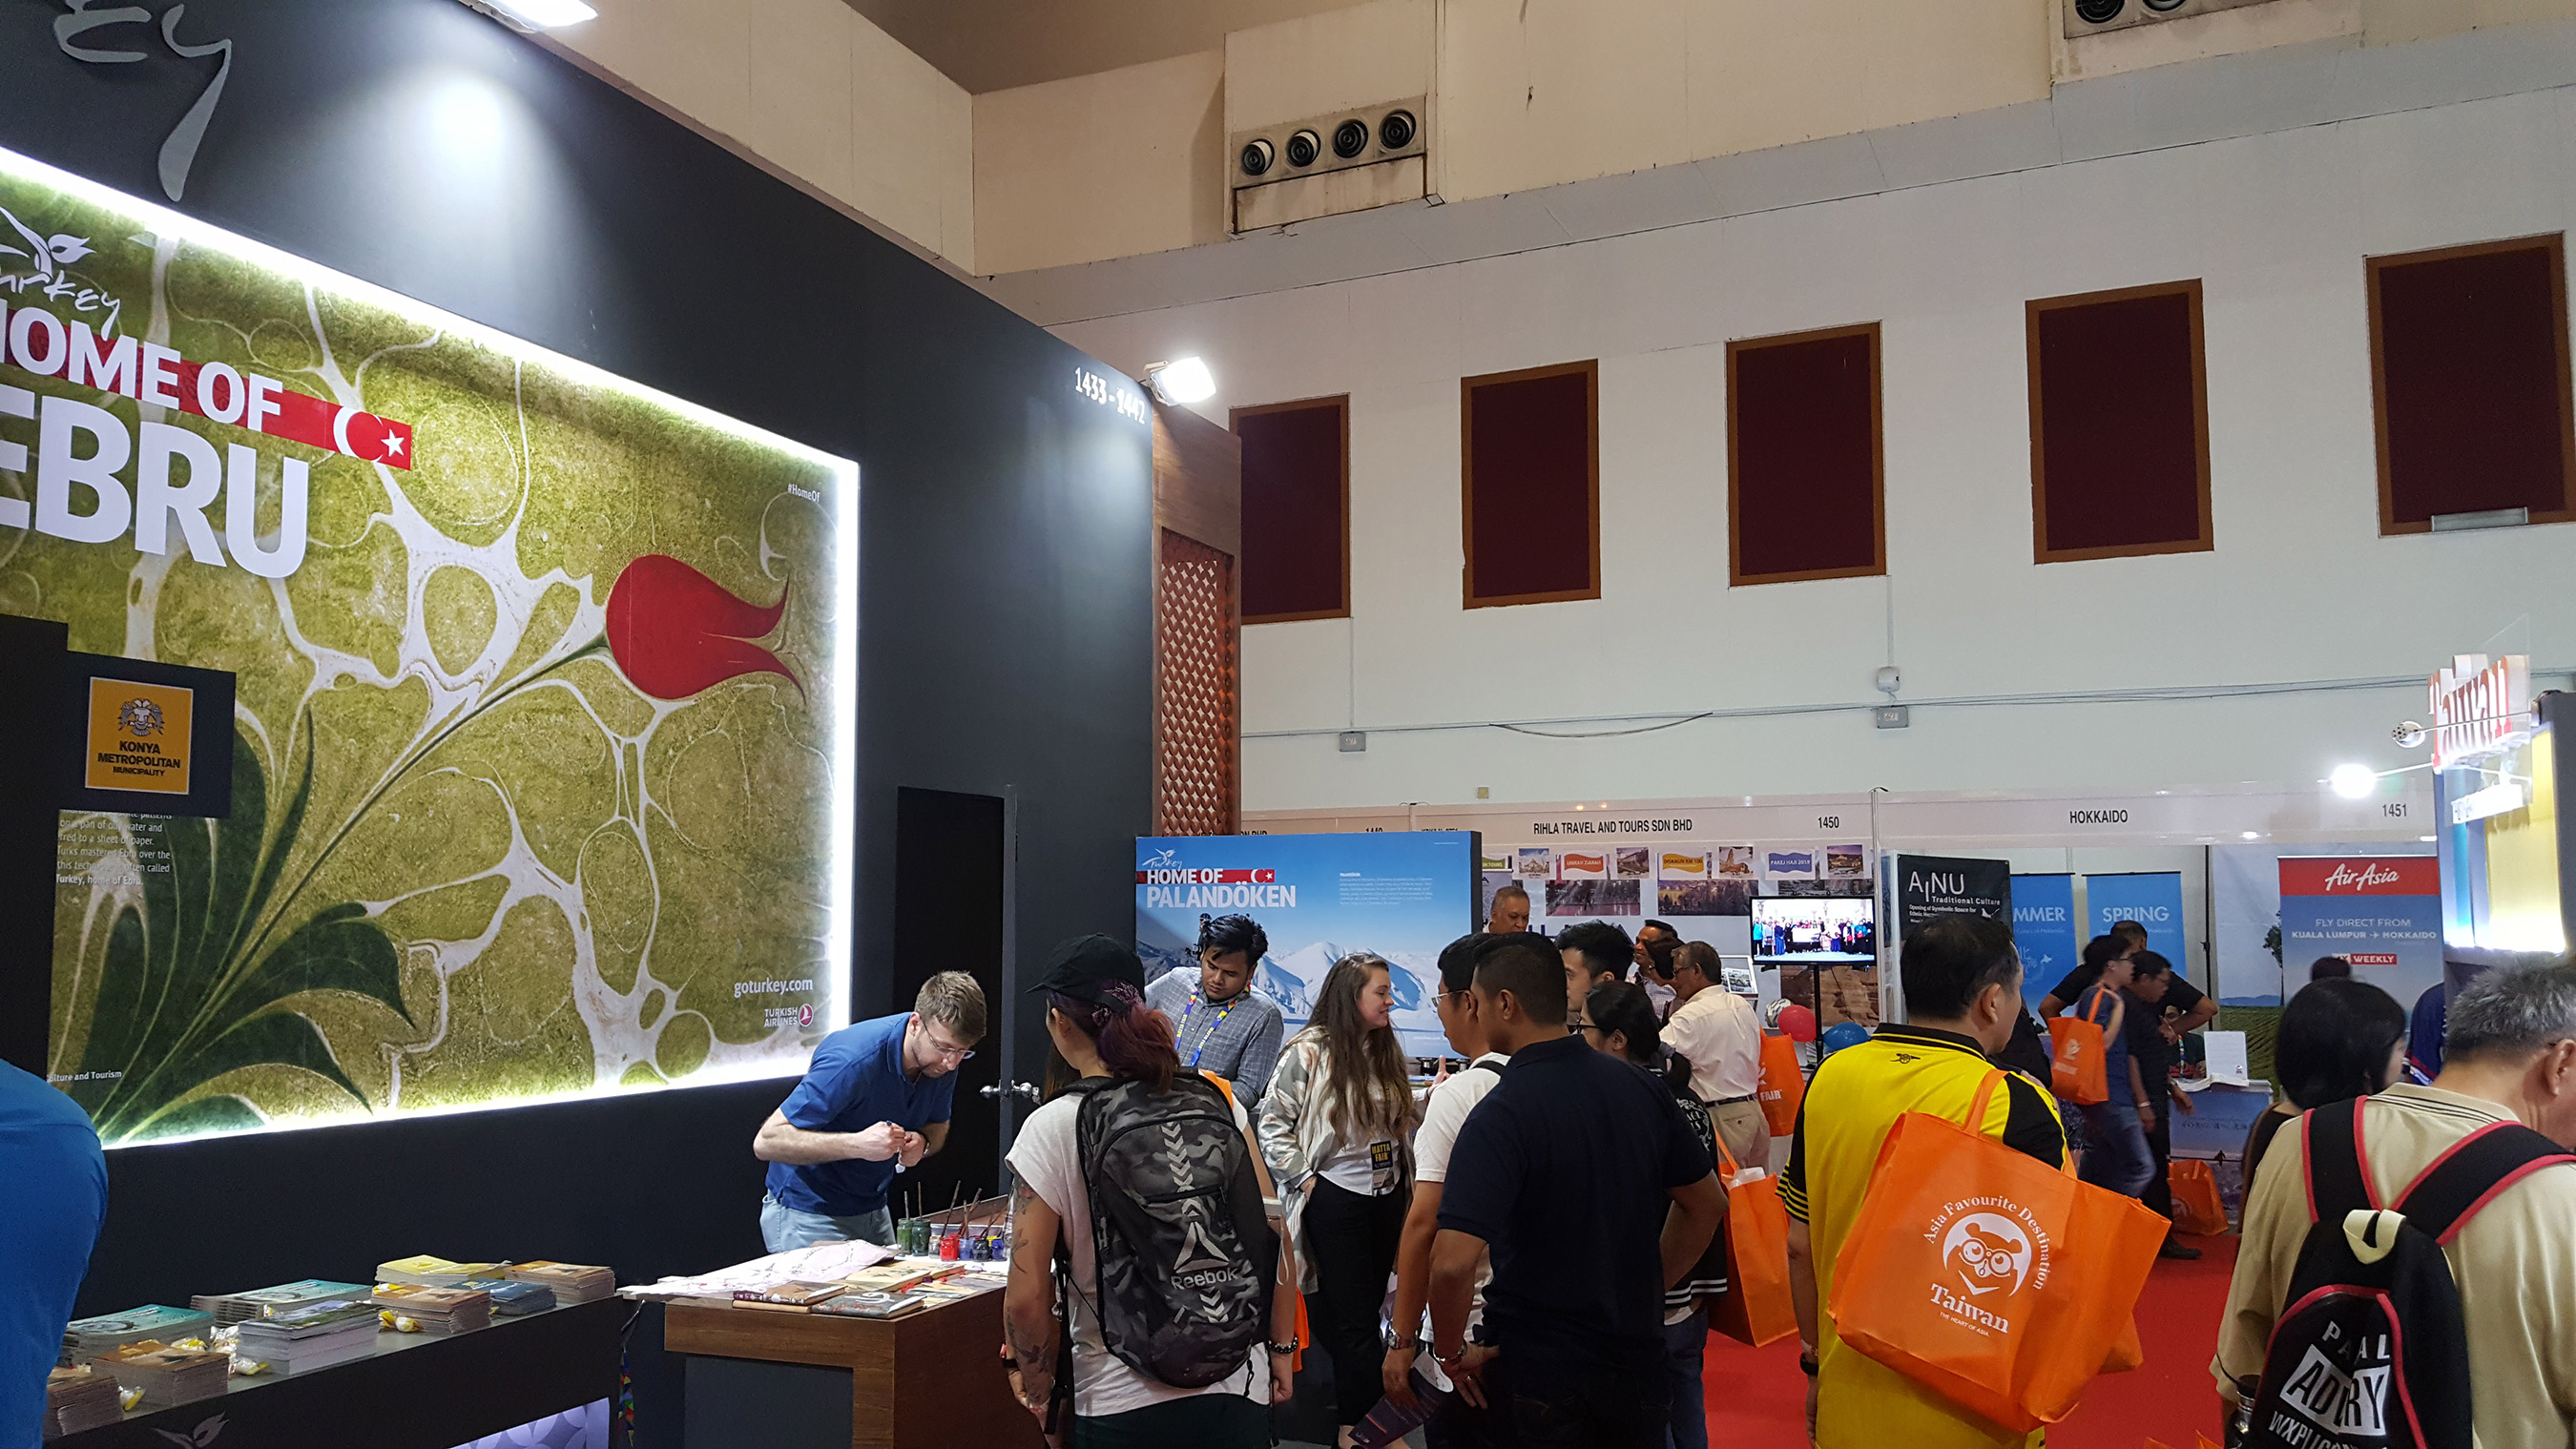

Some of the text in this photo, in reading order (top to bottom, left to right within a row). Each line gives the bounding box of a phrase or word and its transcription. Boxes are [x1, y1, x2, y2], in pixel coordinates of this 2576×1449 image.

[197, 361, 283, 433] OF
[787, 483, 821, 503] #HomeOf
[119, 740, 160, 755] KONYA
[97, 753, 181, 768] METROPOLITAN
[113, 766, 165, 776] MUNICIPALITY
[2069, 809, 2129, 824] HOKKAIDO
[2382, 803, 2407, 818] 1451
[80, 821, 95, 830] pan
[1533, 818, 1693, 835] RIHLA TRAVEL AND TOURS SDN BHD
[1818, 816, 1839, 829] 1450
[132, 837, 155, 846] paper.
[157, 850, 171, 859] the
[57, 860, 72, 869] this
[147, 863, 170, 873] called
[1147, 868, 1224, 884] HOME OF
[1147, 880, 1297, 908] PALANDÖKEN
[1932, 896, 2001, 906] Traditional Culture
[2013, 906, 2067, 922] MMER
[2102, 906, 2171, 922] SPRING
[2316, 919, 2412, 927] FLY DIRECT FROM
[2292, 931, 2437, 940] KUALA LUMPUR HOKKAIDO
[2353, 955, 2396, 963] WEEKLY
[734, 977, 813, 999] goturkey.com
[764, 1007, 798, 1018] TURKISH
[764, 1017, 798, 1027] AIRLINES
[73, 1071, 89, 1081] and
[91, 1070, 122, 1080] Tourism
[1371, 1143, 1391, 1155] MATTA
[1375, 1151, 1388, 1162] FAIR
[1922, 1195, 2051, 1291] Asia Favourite Destination
[1171, 1266, 1238, 1291] Reebok
[1930, 1282, 2009, 1334] Taiwan
[1940, 1311, 1950, 1320] THE
[1950, 1316, 1968, 1328] HEART
[1976, 1326, 1990, 1337] ASIA
